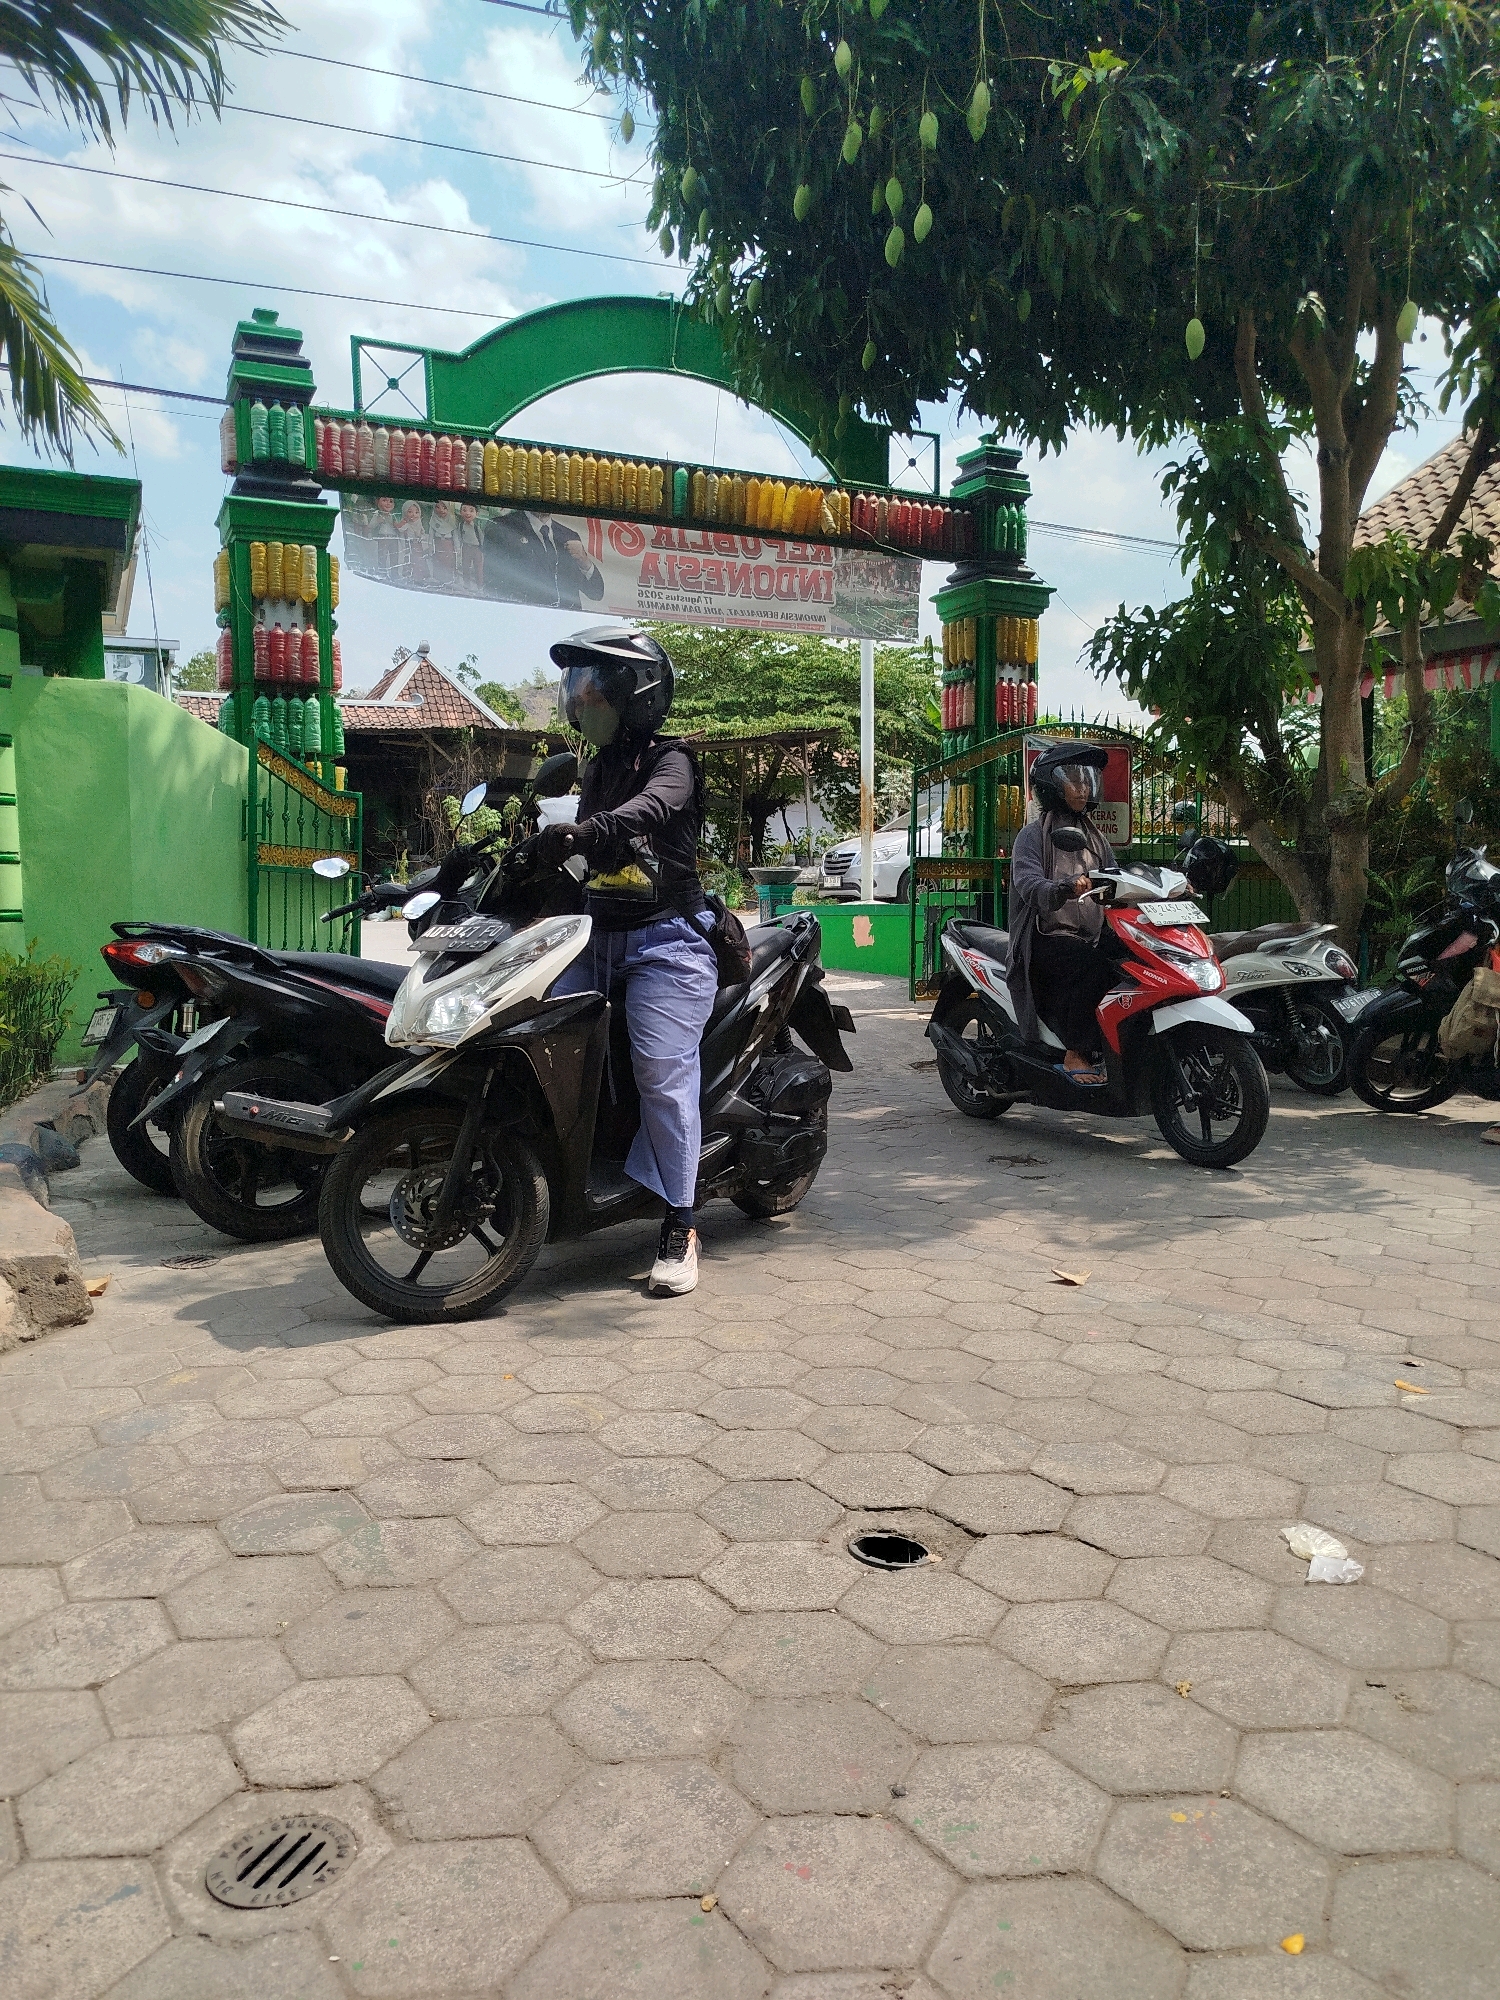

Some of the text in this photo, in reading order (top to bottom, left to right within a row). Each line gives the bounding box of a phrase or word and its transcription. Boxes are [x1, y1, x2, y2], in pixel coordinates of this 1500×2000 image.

[1090, 810, 1117, 821] KERAS
[420, 926, 446, 938] AD
[440, 926, 481, 938] 3947
[1143, 969, 1168, 985] HONDA
